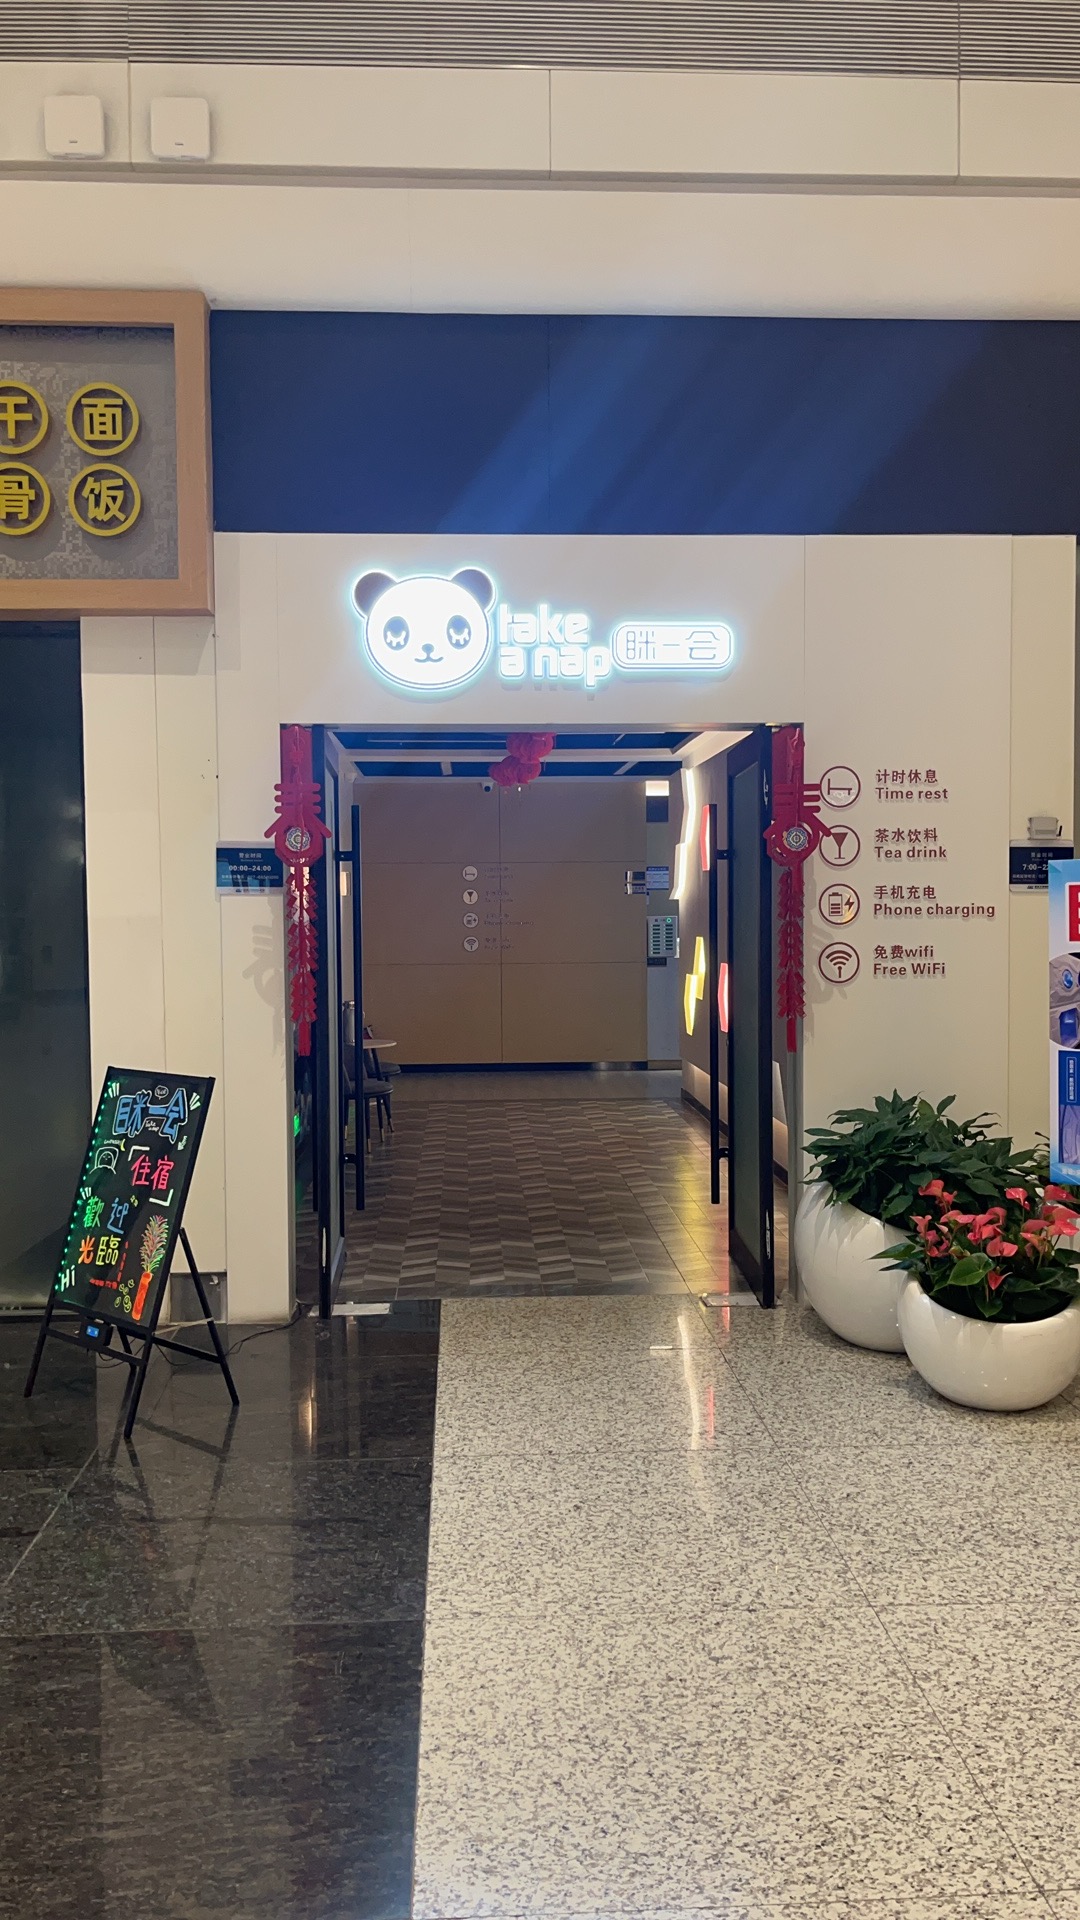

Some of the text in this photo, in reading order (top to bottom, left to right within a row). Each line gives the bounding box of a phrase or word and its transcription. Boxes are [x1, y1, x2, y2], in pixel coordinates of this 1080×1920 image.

[499, 603, 588, 645] take
[625, 630, 721, 661] 眯一会
[499, 645, 611, 688] a nap
[875, 768, 938, 784] 计时休息
[875, 787, 949, 800] Time rest
[875, 827, 938, 843] 茶水饮料
[875, 846, 947, 859] Tea drink
[874, 885, 937, 900] 手机充电
[873, 903, 996, 918] Phone charging
[874, 945, 934, 959] 免费wifi
[873, 963, 946, 976] Free WiFi
[131, 1154, 175, 1191] 住宿
[61, 1264, 76, 1292] Hi
